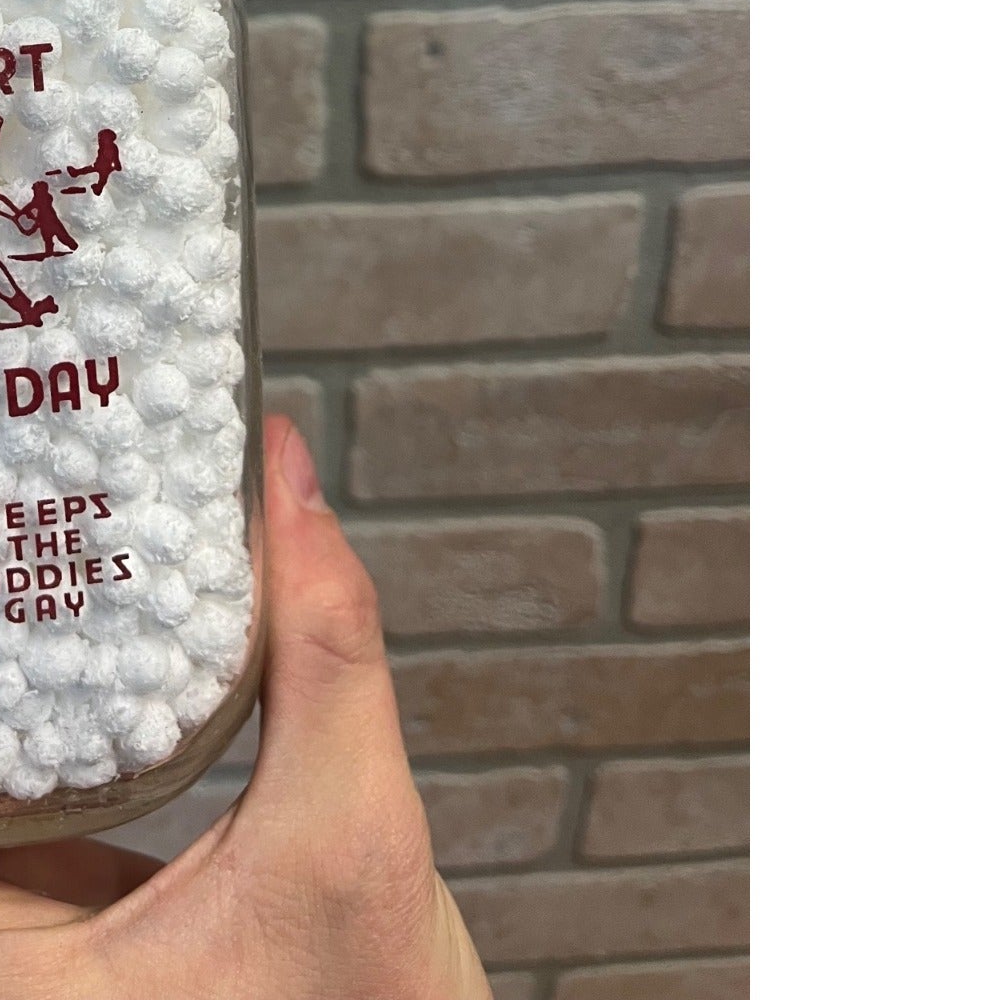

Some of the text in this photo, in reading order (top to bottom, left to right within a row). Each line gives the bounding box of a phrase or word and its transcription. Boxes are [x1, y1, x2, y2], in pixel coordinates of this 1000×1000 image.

[4, 355, 120, 418] DAY
[6, 528, 82, 561] THE
[4, 591, 84, 624] GAY
